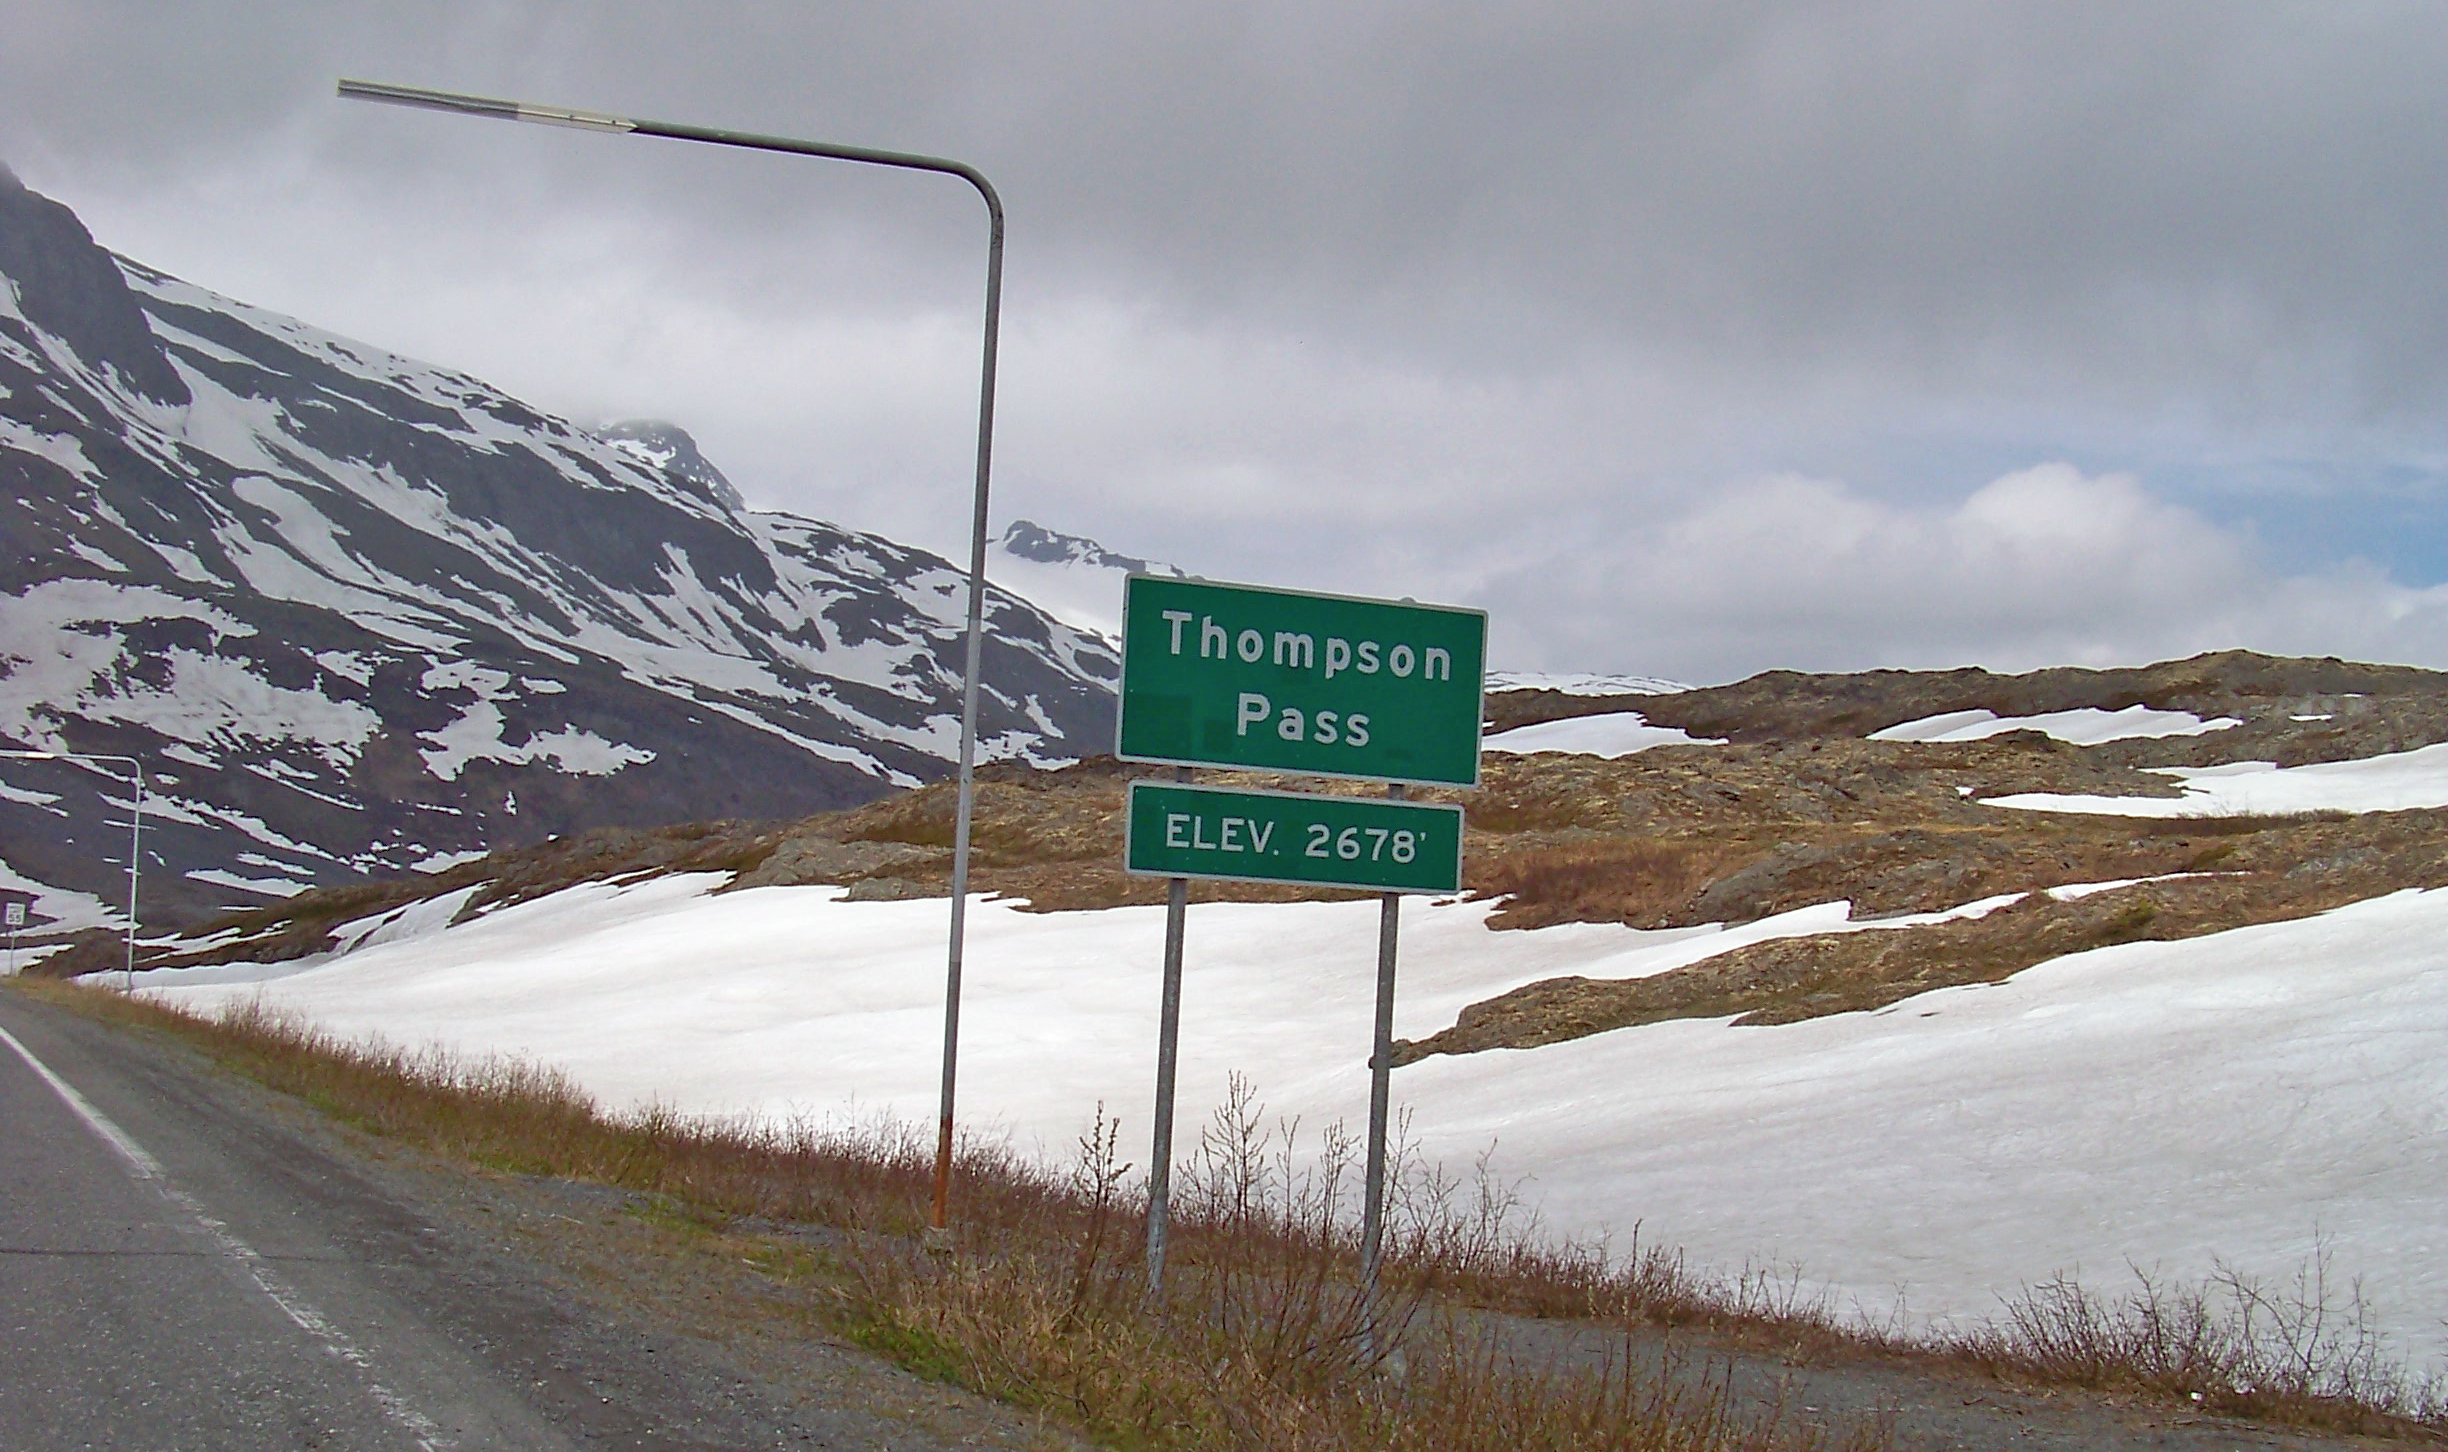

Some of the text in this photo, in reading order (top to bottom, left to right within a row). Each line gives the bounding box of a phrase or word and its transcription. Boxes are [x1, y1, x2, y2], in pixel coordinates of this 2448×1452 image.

[1162, 610, 1451, 681] Thompson
[1236, 692, 1370, 747] Pass
[1165, 813, 1427, 864] ELEV. 2678'
